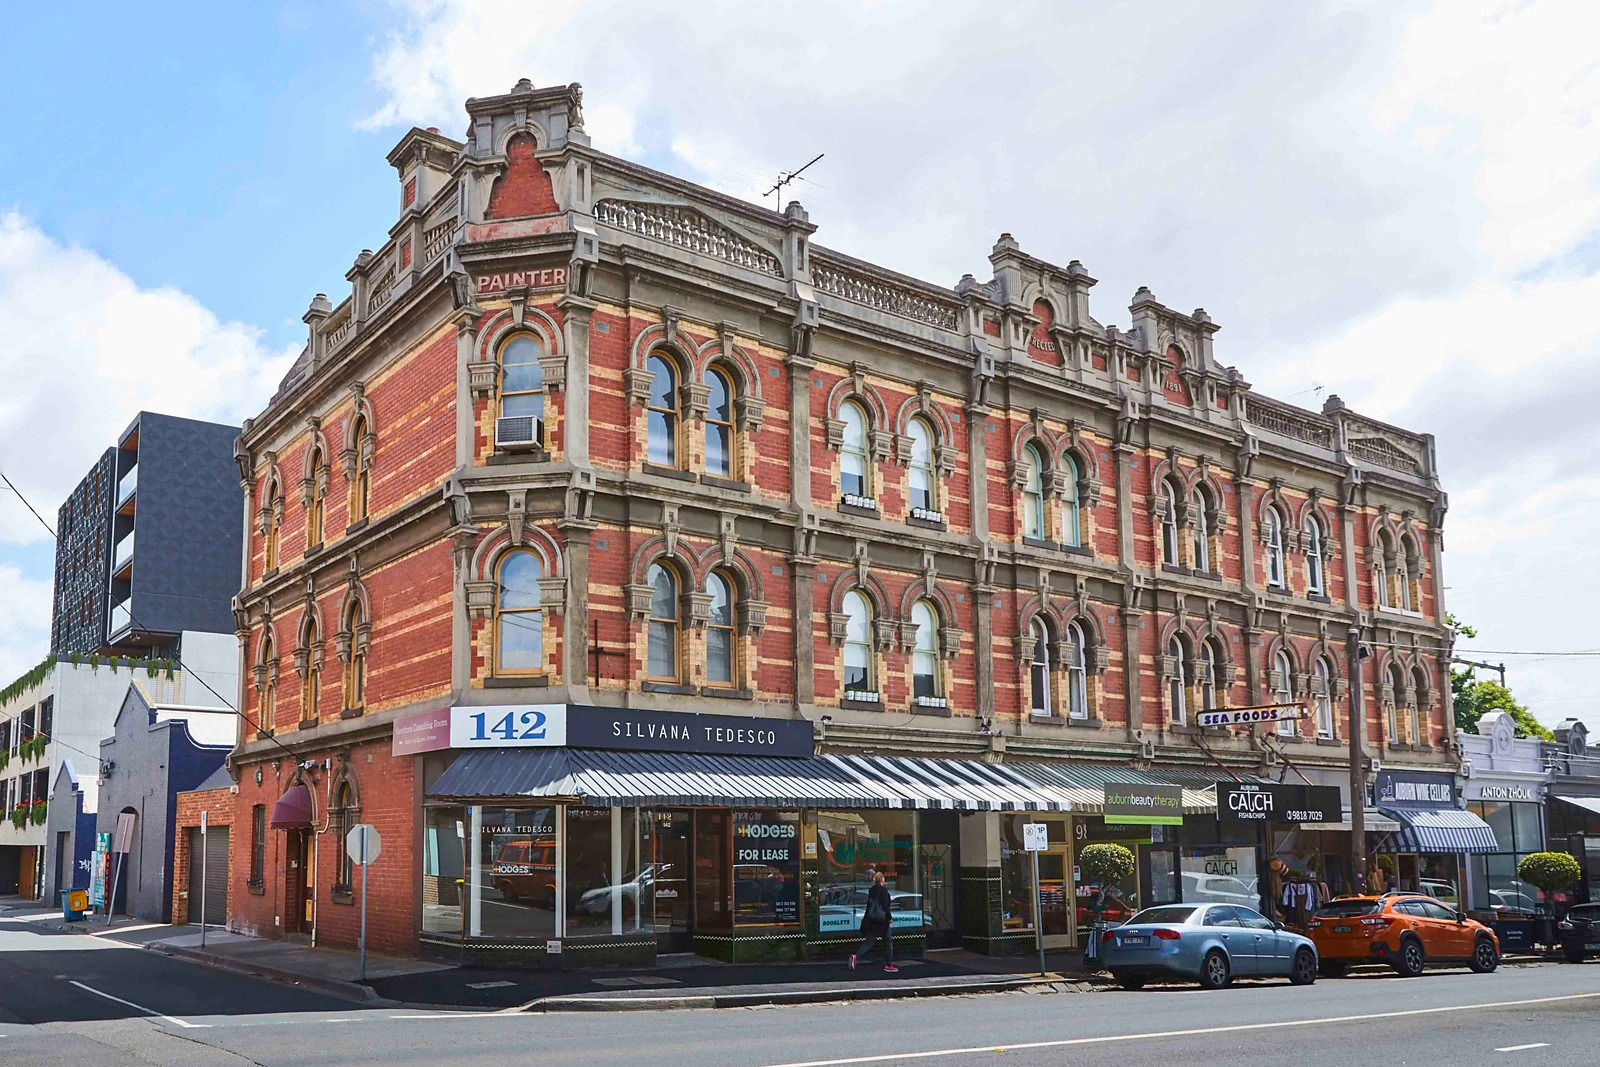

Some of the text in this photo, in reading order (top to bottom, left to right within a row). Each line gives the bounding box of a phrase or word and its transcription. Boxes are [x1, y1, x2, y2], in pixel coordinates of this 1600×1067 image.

[477, 267, 566, 292] PAINTER
[1031, 336, 1056, 351] RECTED
[1165, 380, 1182, 392] 1891
[1204, 709, 1278, 725] SEA FOODS
[469, 711, 547, 740] 142
[613, 721, 776, 745] SILVANA TEDESCO
[1482, 786, 1507, 798] ANTON
[1292, 811, 1323, 820] 9818 7029
[739, 849, 789, 860] FOR LEASE
